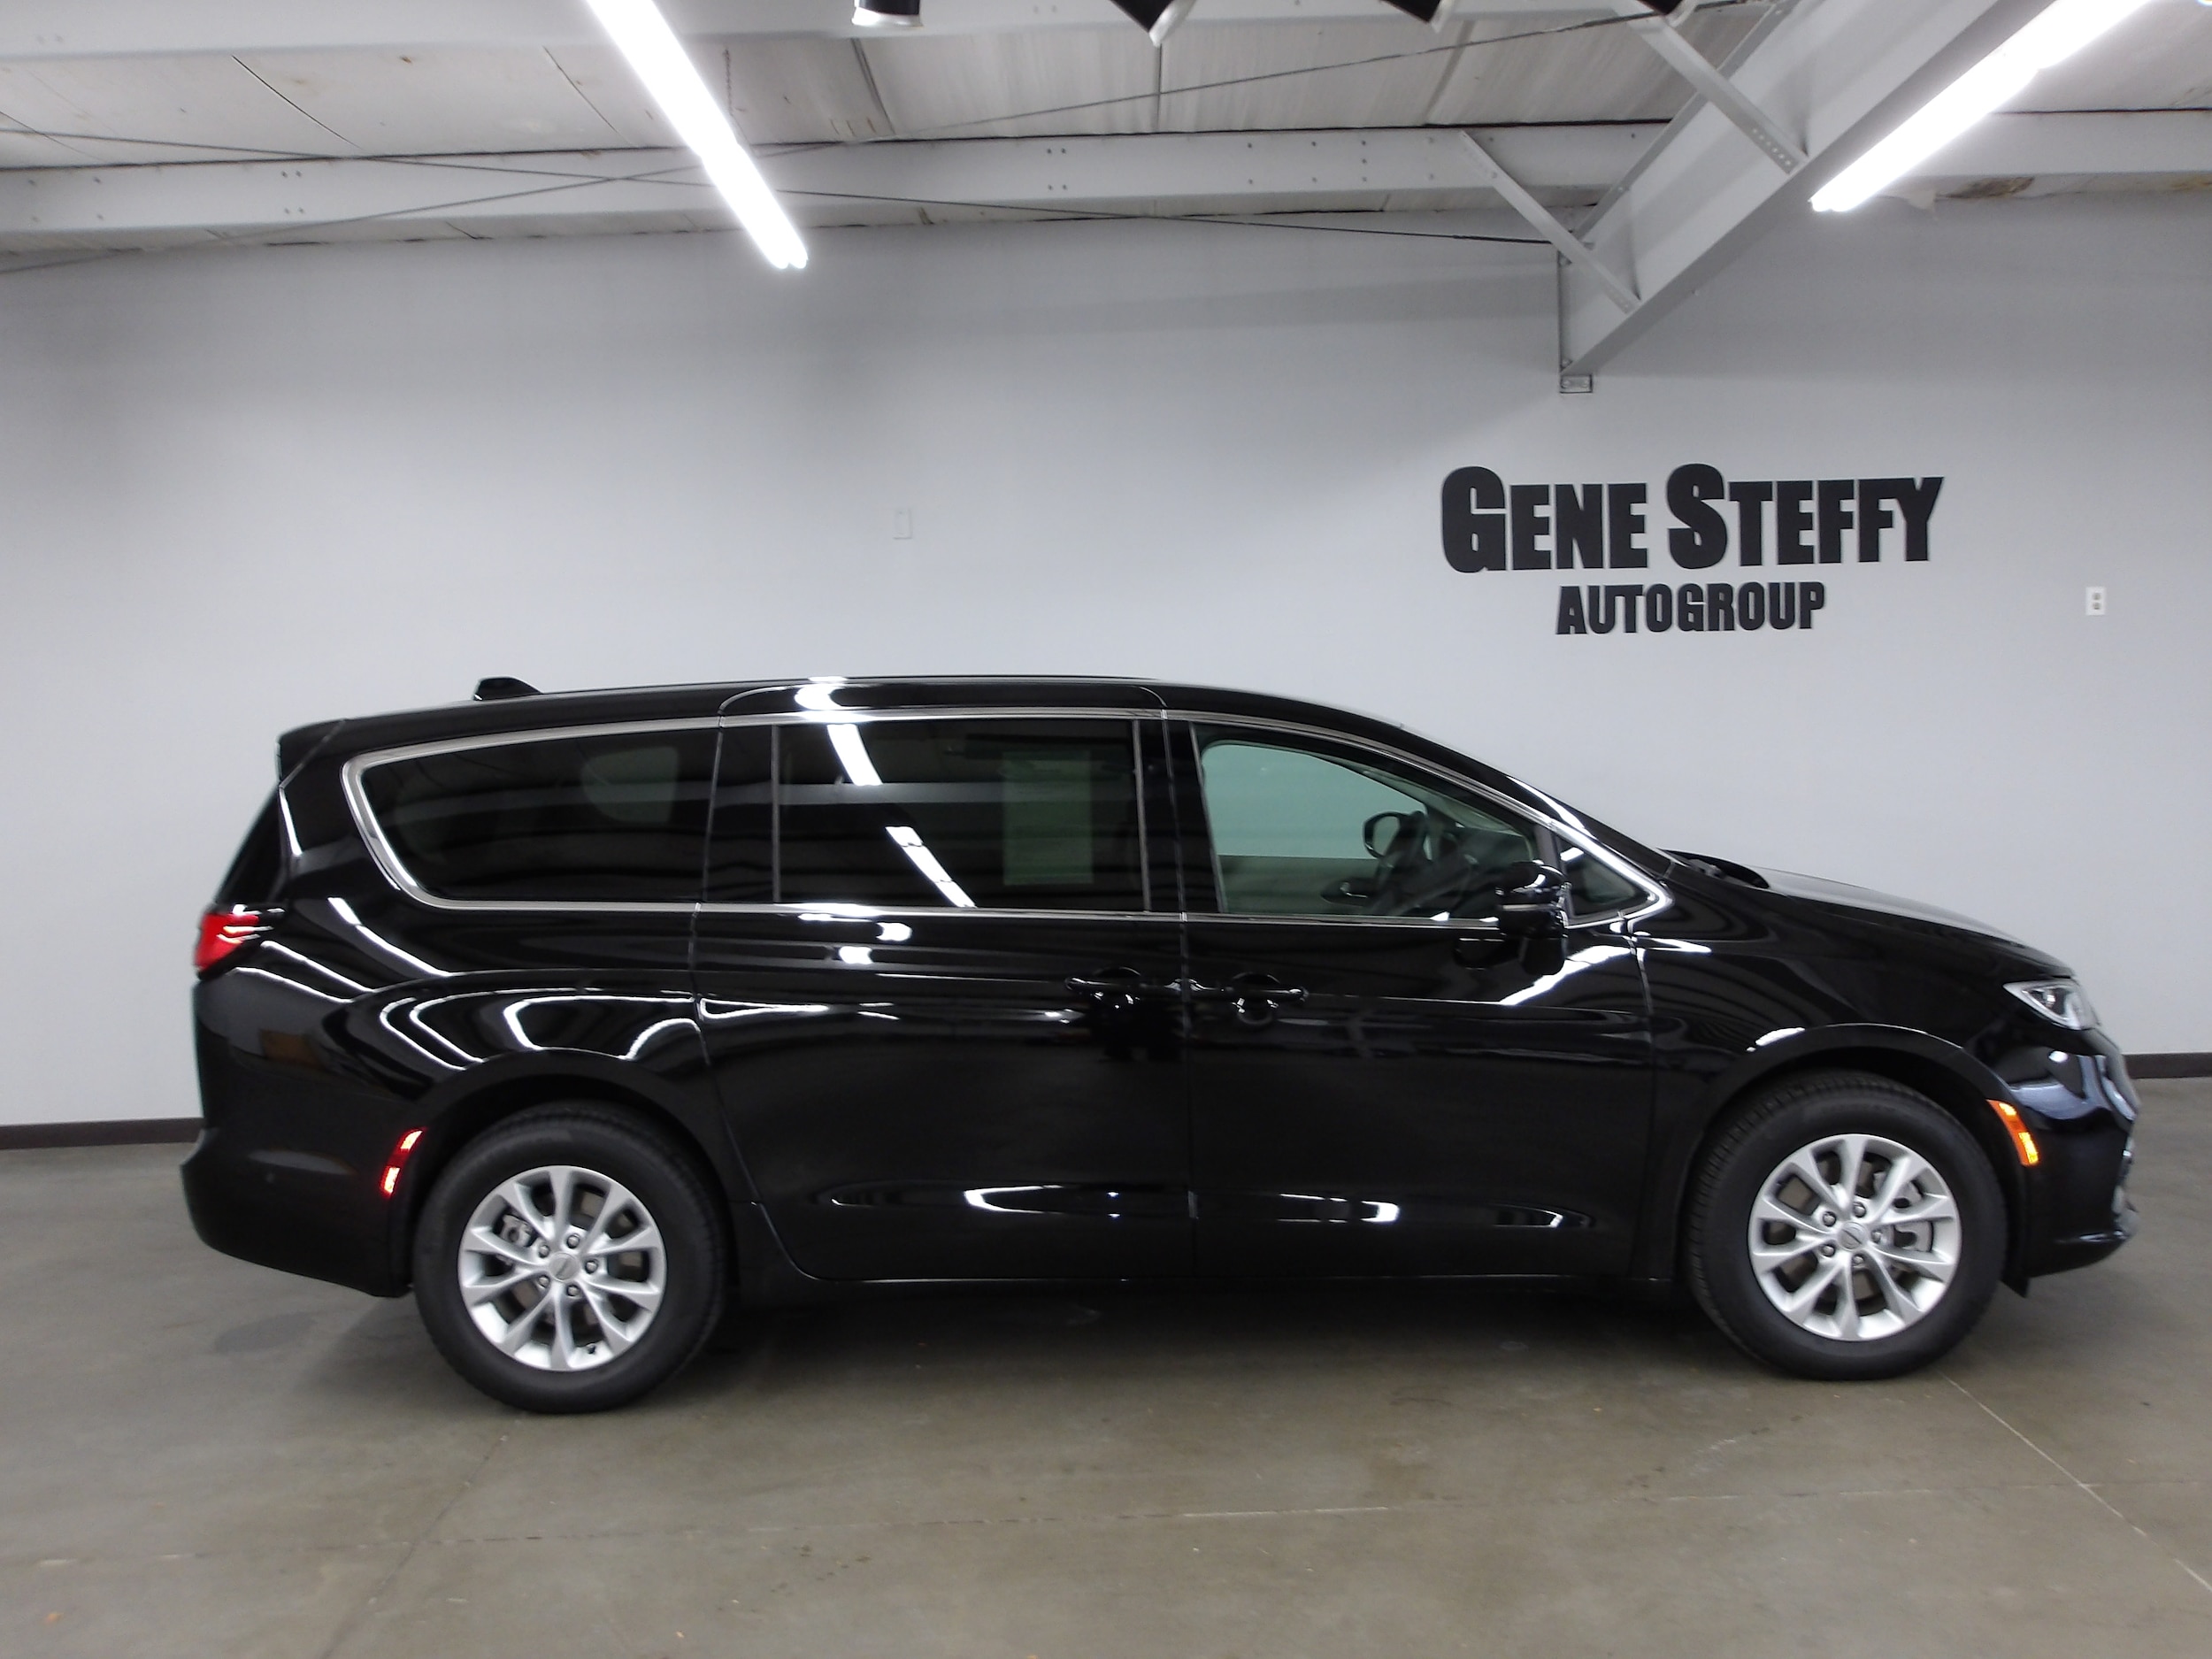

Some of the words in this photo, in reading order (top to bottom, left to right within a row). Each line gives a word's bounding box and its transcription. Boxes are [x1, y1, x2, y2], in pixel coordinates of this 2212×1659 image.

[1441, 465, 1648, 573] GENE
[1666, 463, 1945, 570] STEFFY
[1555, 581, 1825, 635] AUTOGROUP
